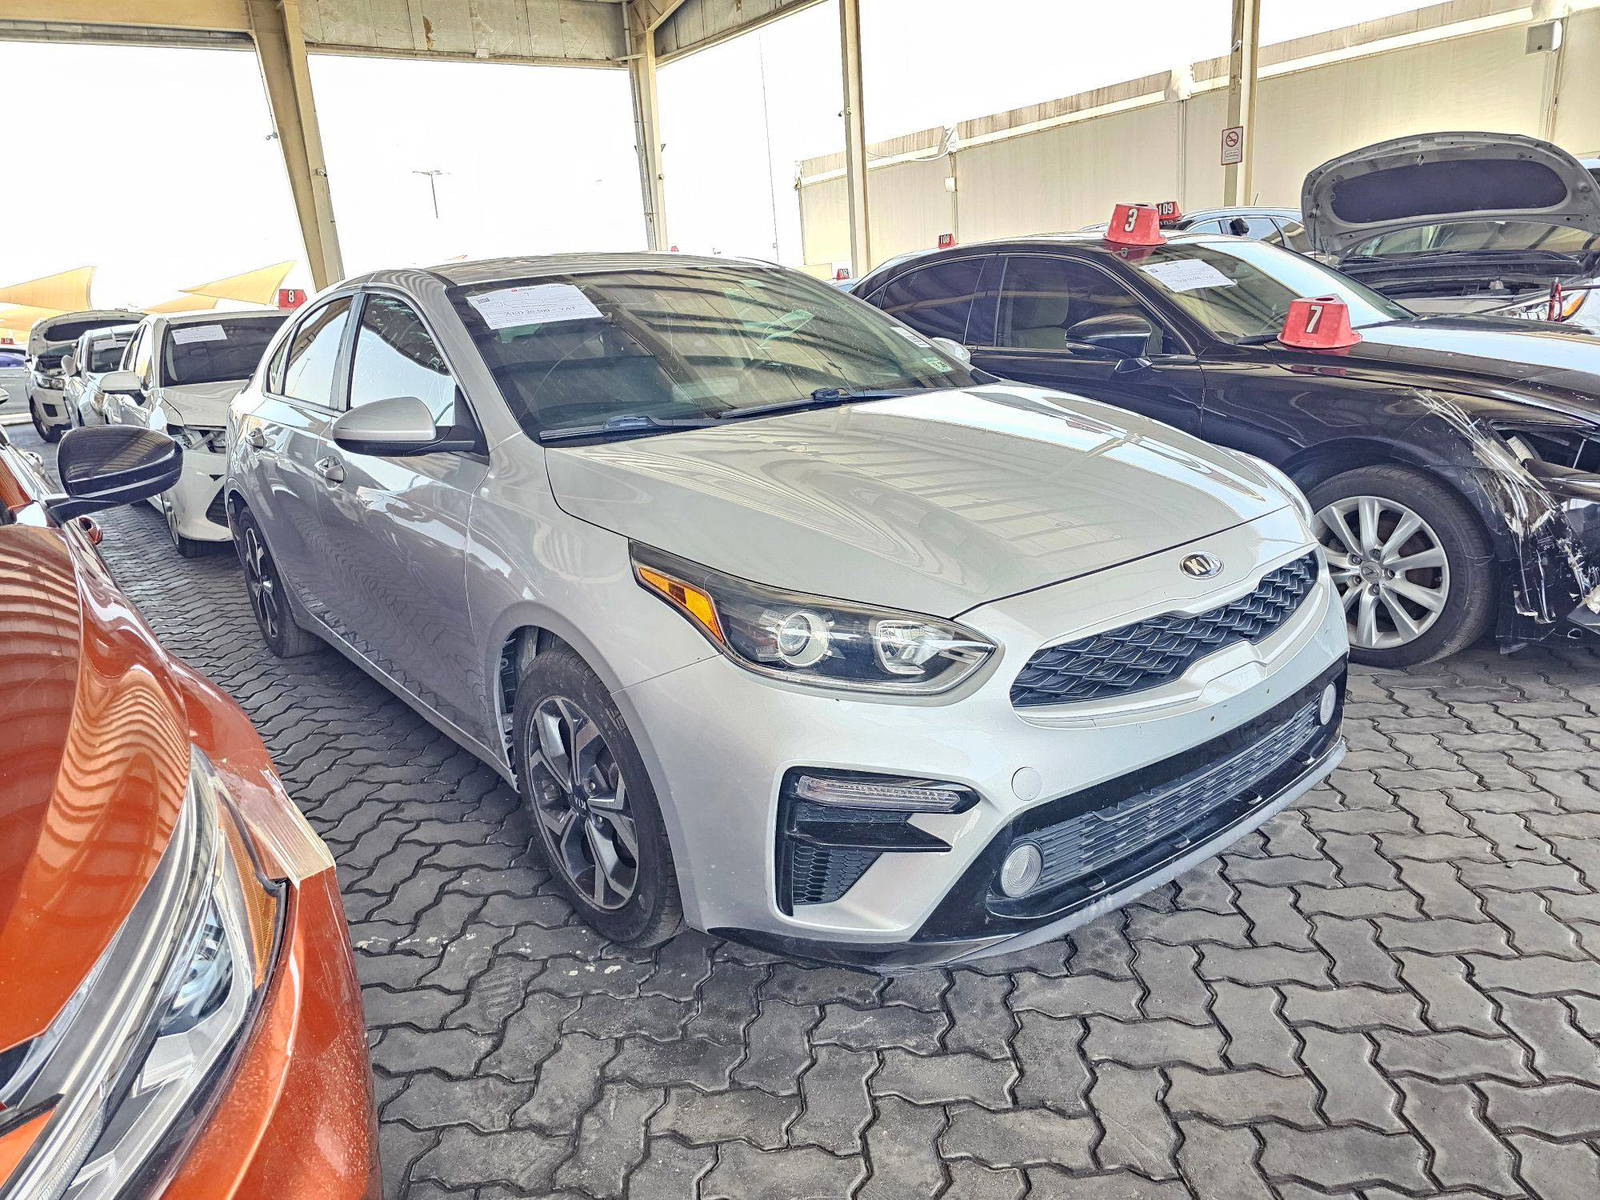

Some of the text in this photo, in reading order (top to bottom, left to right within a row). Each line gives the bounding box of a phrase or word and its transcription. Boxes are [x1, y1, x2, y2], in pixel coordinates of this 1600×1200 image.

[1158, 203, 1174, 216] 109
[1125, 208, 1138, 232] 3
[288, 290, 295, 303] 8
[1306, 305, 1323, 333] 7
[1184, 556, 1220, 575] KIA
